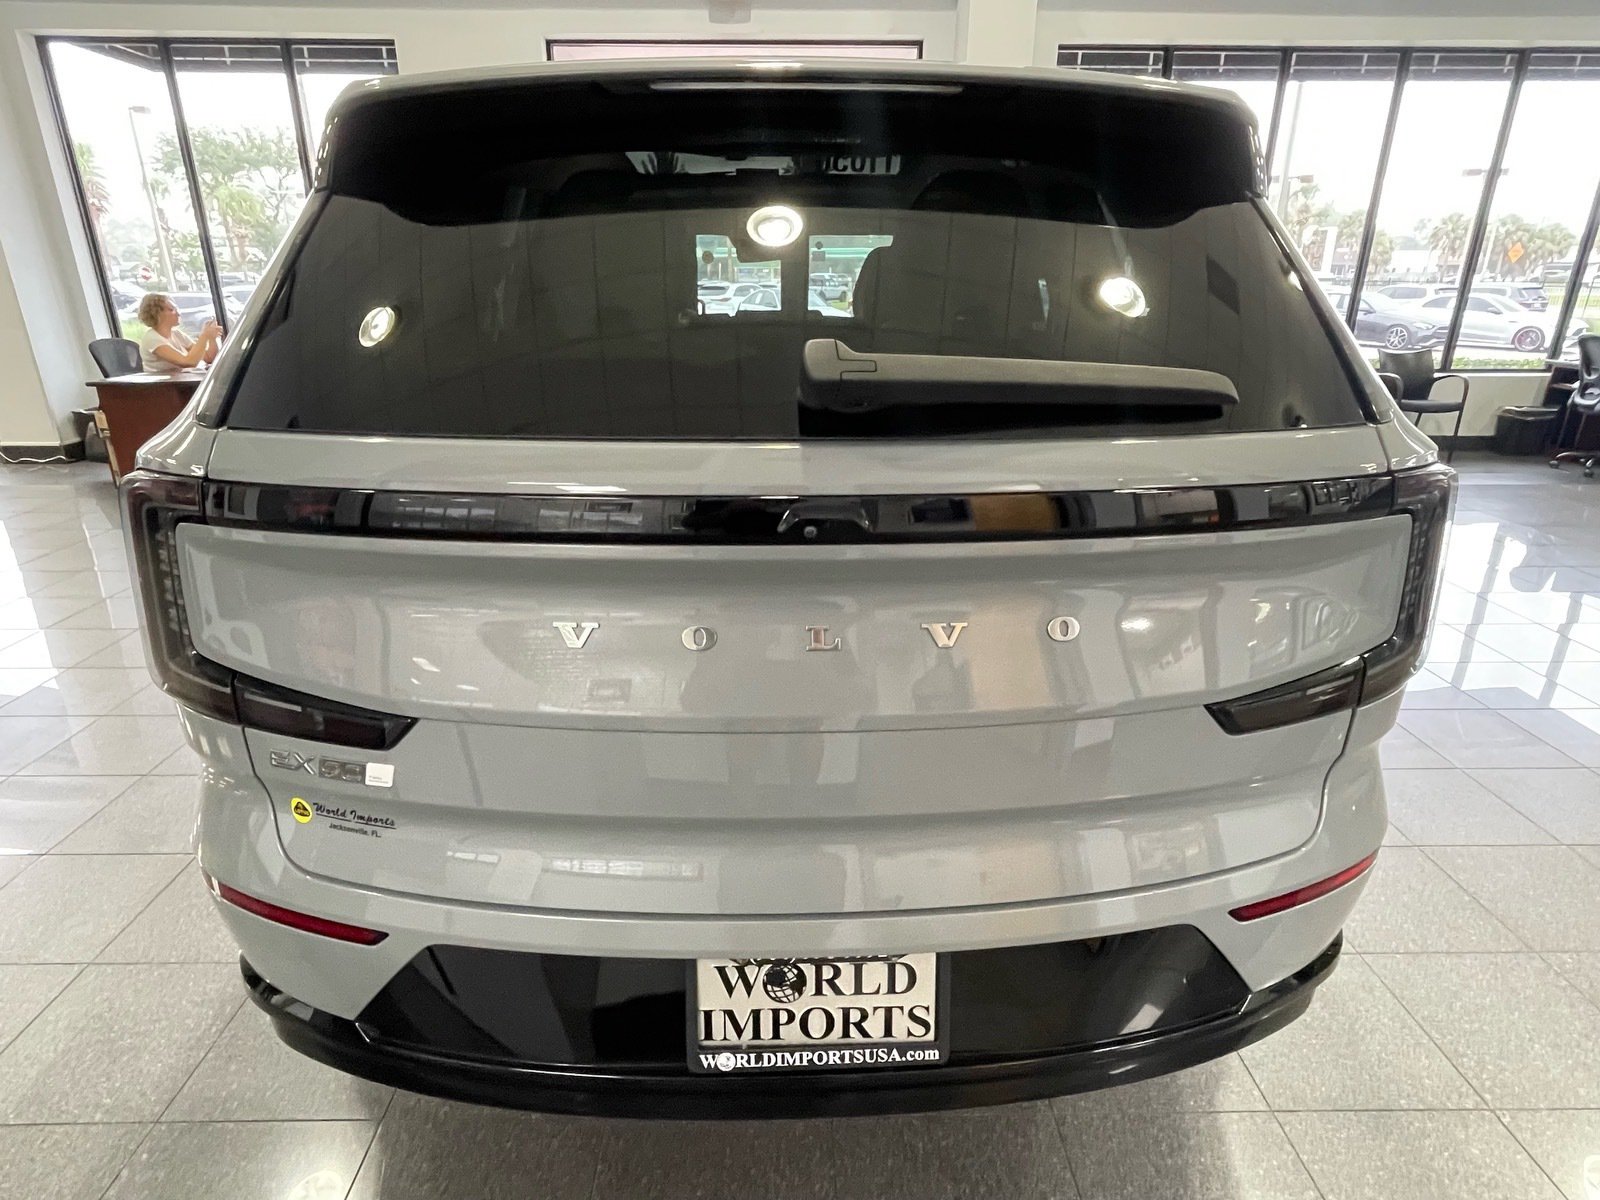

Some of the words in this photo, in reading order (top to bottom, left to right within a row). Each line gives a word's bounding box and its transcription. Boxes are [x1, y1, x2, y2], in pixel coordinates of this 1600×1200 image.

[553, 616, 1080, 651] VOLVO
[312, 802, 347, 818] World
[700, 1004, 932, 1042] IMPORTS
